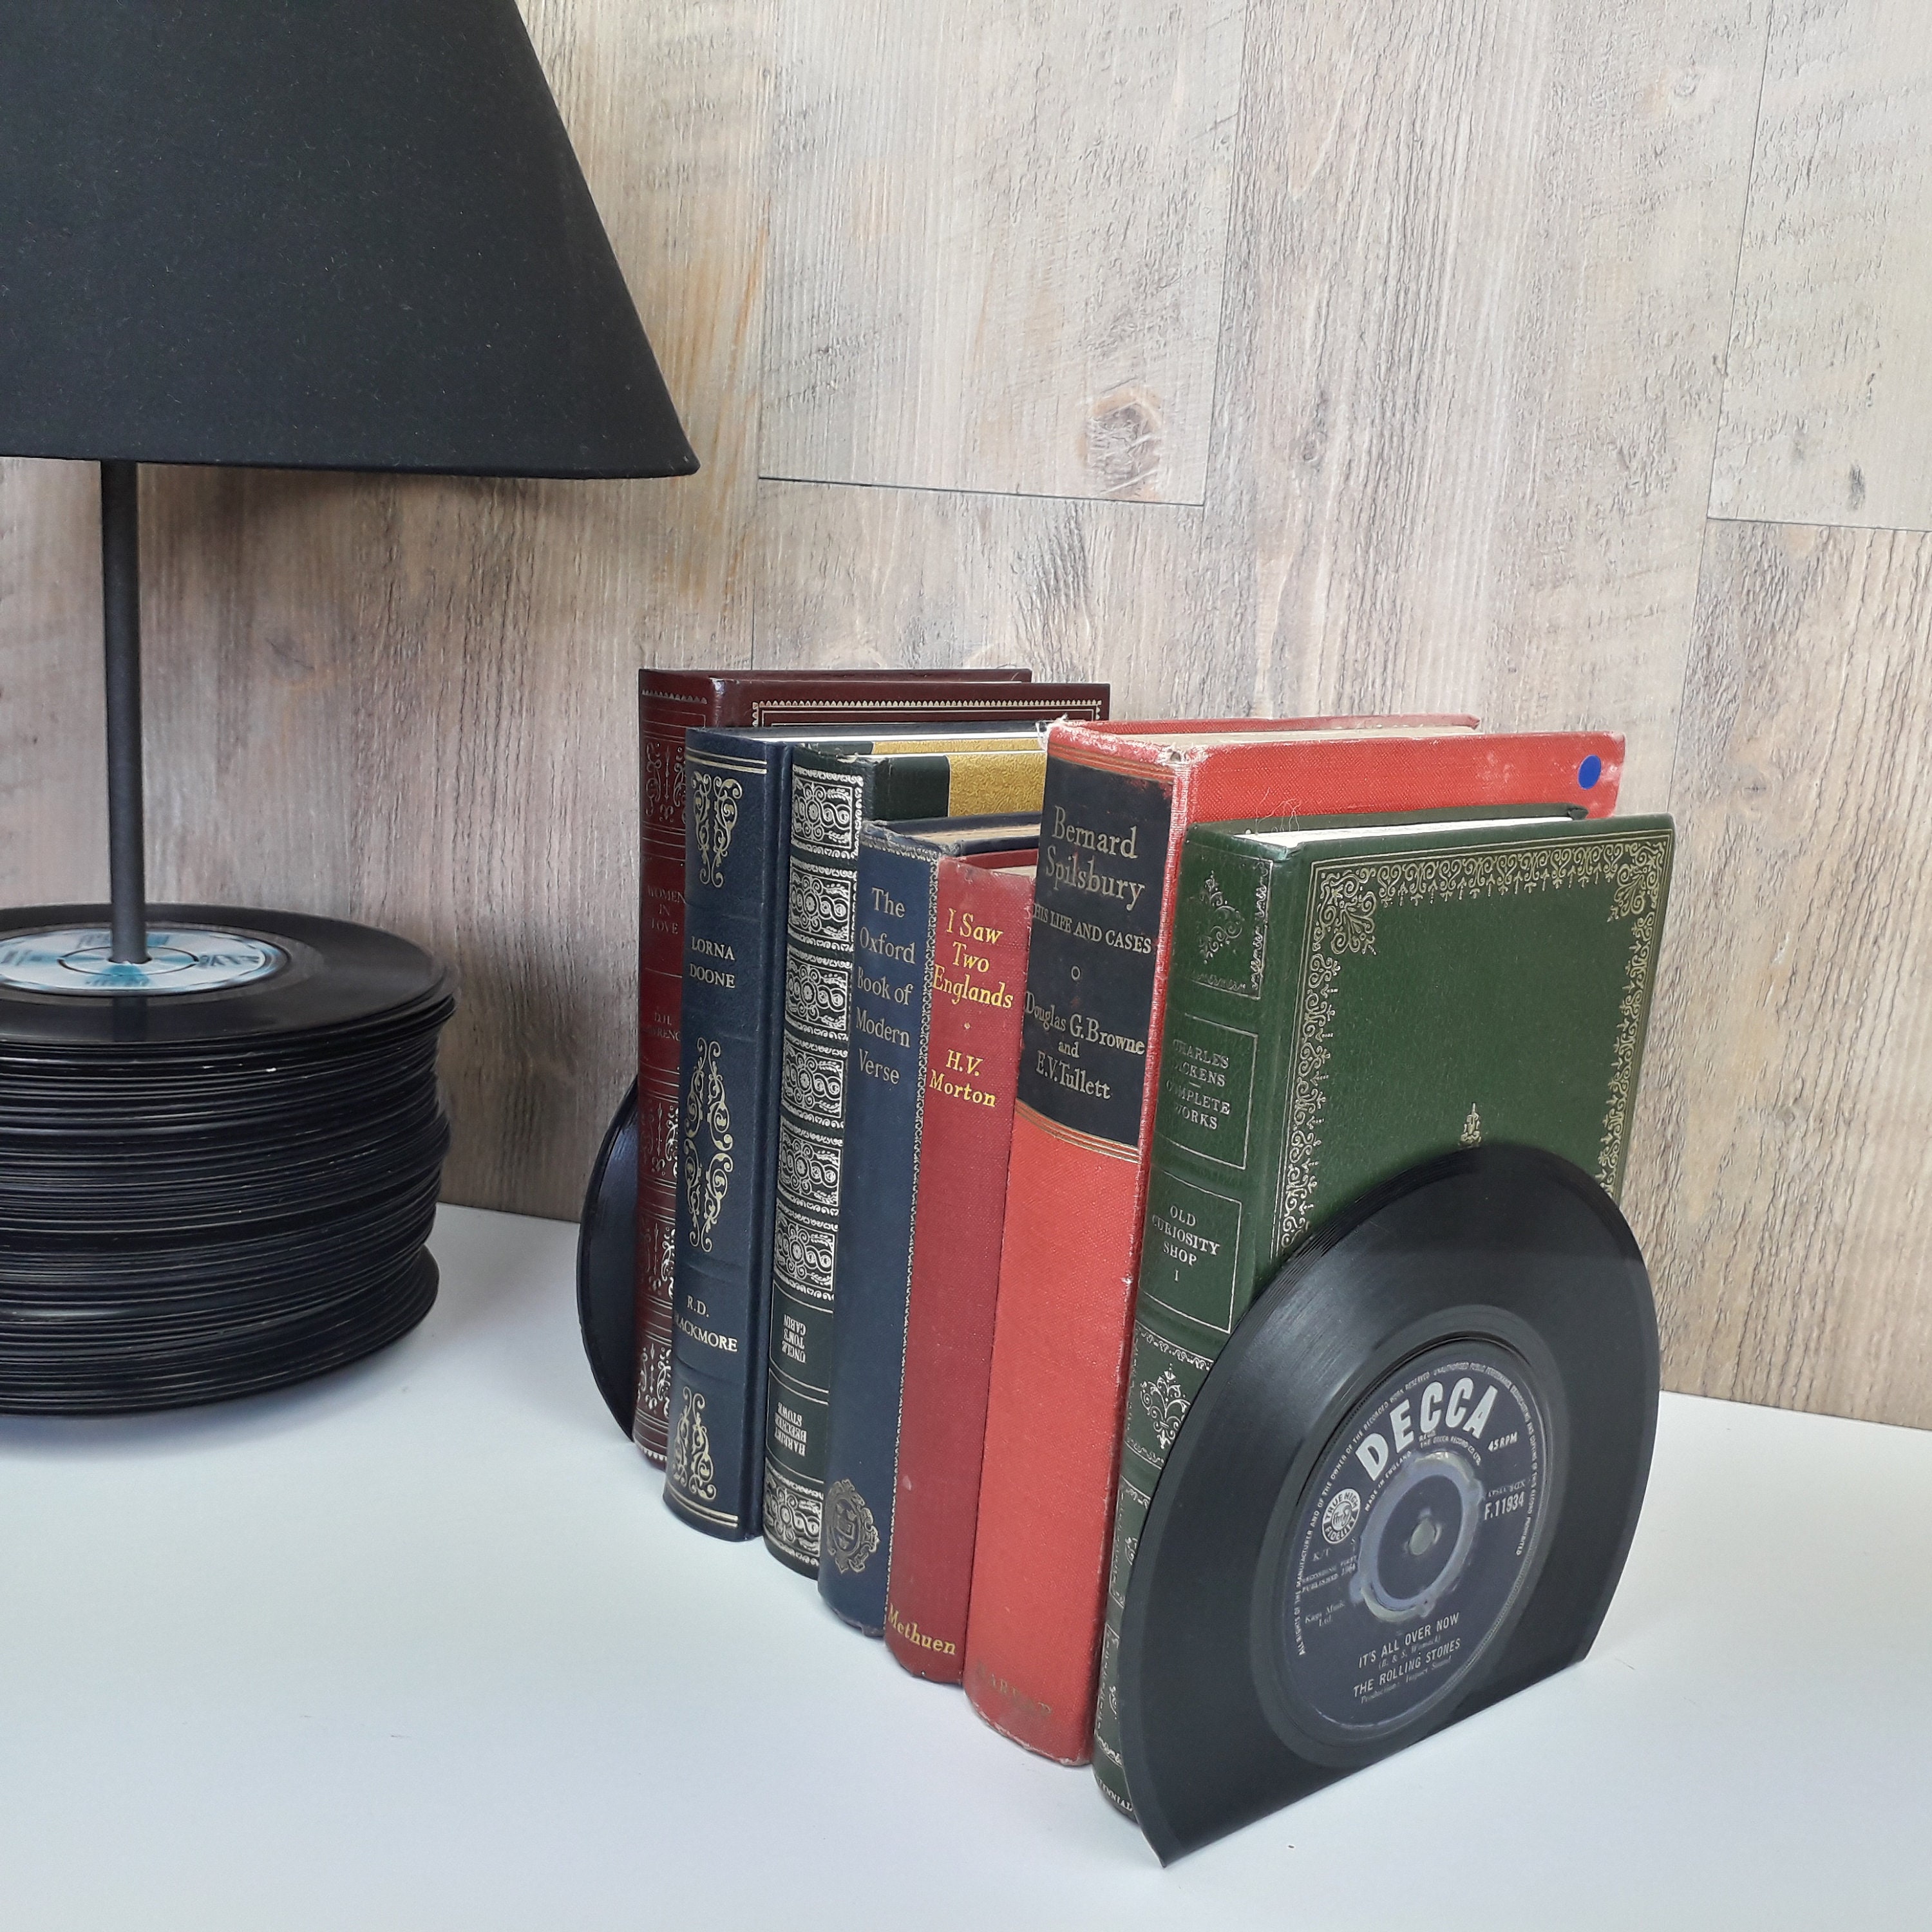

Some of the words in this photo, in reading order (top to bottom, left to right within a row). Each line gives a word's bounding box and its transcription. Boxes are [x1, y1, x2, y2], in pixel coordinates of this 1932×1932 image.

[1052, 805, 1139, 860] Bernard
[1046, 844, 1146, 911] Spilsbury
[659, 904, 670, 916] IN
[871, 887, 905, 918] The
[946, 907, 957, 933] I
[959, 913, 1003, 945] Saw
[1033, 903, 1049, 923] HIS
[1050, 910, 1072, 934] LIFE
[1073, 921, 1103, 943] AND
[1105, 929, 1152, 954] CASES
[691, 936, 735, 960] LORNA
[859, 927, 916, 965] Oxford
[952, 941, 990, 974] Two
[690, 963, 735, 989] DOONE
[858, 967, 891, 1001] Book
[895, 983, 913, 1006] of
[933, 964, 1014, 1009] Englands
[855, 1007, 911, 1048] Modern
[1025, 990, 1066, 1031] Douglas
[859, 1048, 900, 1085] Verse
[946, 1049, 983, 1077] H.V.
[1058, 1041, 1081, 1059] and
[929, 1069, 996, 1108] Morton
[1173, 1059, 1226, 1087] CKENS
[1166, 1080, 1231, 1115] CMPLETE
[1170, 1205, 1197, 1227] OLD
[1152, 1214, 1220, 1256] CURIOSITY
[1163, 1240, 1197, 1266] SHOP
[1174, 1269, 1179, 1282] I
[687, 1295, 710, 1318] R.D.
[783, 1314, 806, 1336] CABIN
[781, 1340, 806, 1364] UNCLE
[777, 1401, 803, 1427] STOWE
[1355, 1377, 1498, 1481] DECCA
[1420, 1439, 1430, 1448] THE
[1433, 1435, 1449, 1444] DECCA
[1310, 1510, 1320, 1528] AND
[1317, 1498, 1325, 1508] OF
[1321, 1481, 1332, 1496] THE
[1330, 1454, 1347, 1480] OWNER
[1345, 1444, 1353, 1454] OF
[1352, 1430, 1364, 1443] THE
[1363, 1401, 1388, 1432] RECORDED
[1365, 1488, 1378, 1511] MADE
[1378, 1479, 1385, 1488] IN
[1385, 1450, 1412, 1479] ENGLAND
[1324, 1493, 1343, 1520] TRUE
[1344, 1492, 1359, 1508] HIGH
[1484, 1491, 1525, 1520] F.11934
[1325, 1515, 1356, 1540] FIDELITY
[887, 1602, 956, 1656] Methuen
[1359, 1650, 1376, 1669] IT'S
[1381, 1640, 1400, 1658] ALL
[1405, 1624, 1432, 1646] OVER
[1436, 1612, 1460, 1633] NOW
[1353, 1678, 1374, 1698] THE
[1379, 1656, 1421, 1686] ROLLING
[1426, 1638, 1461, 1663] STONES
